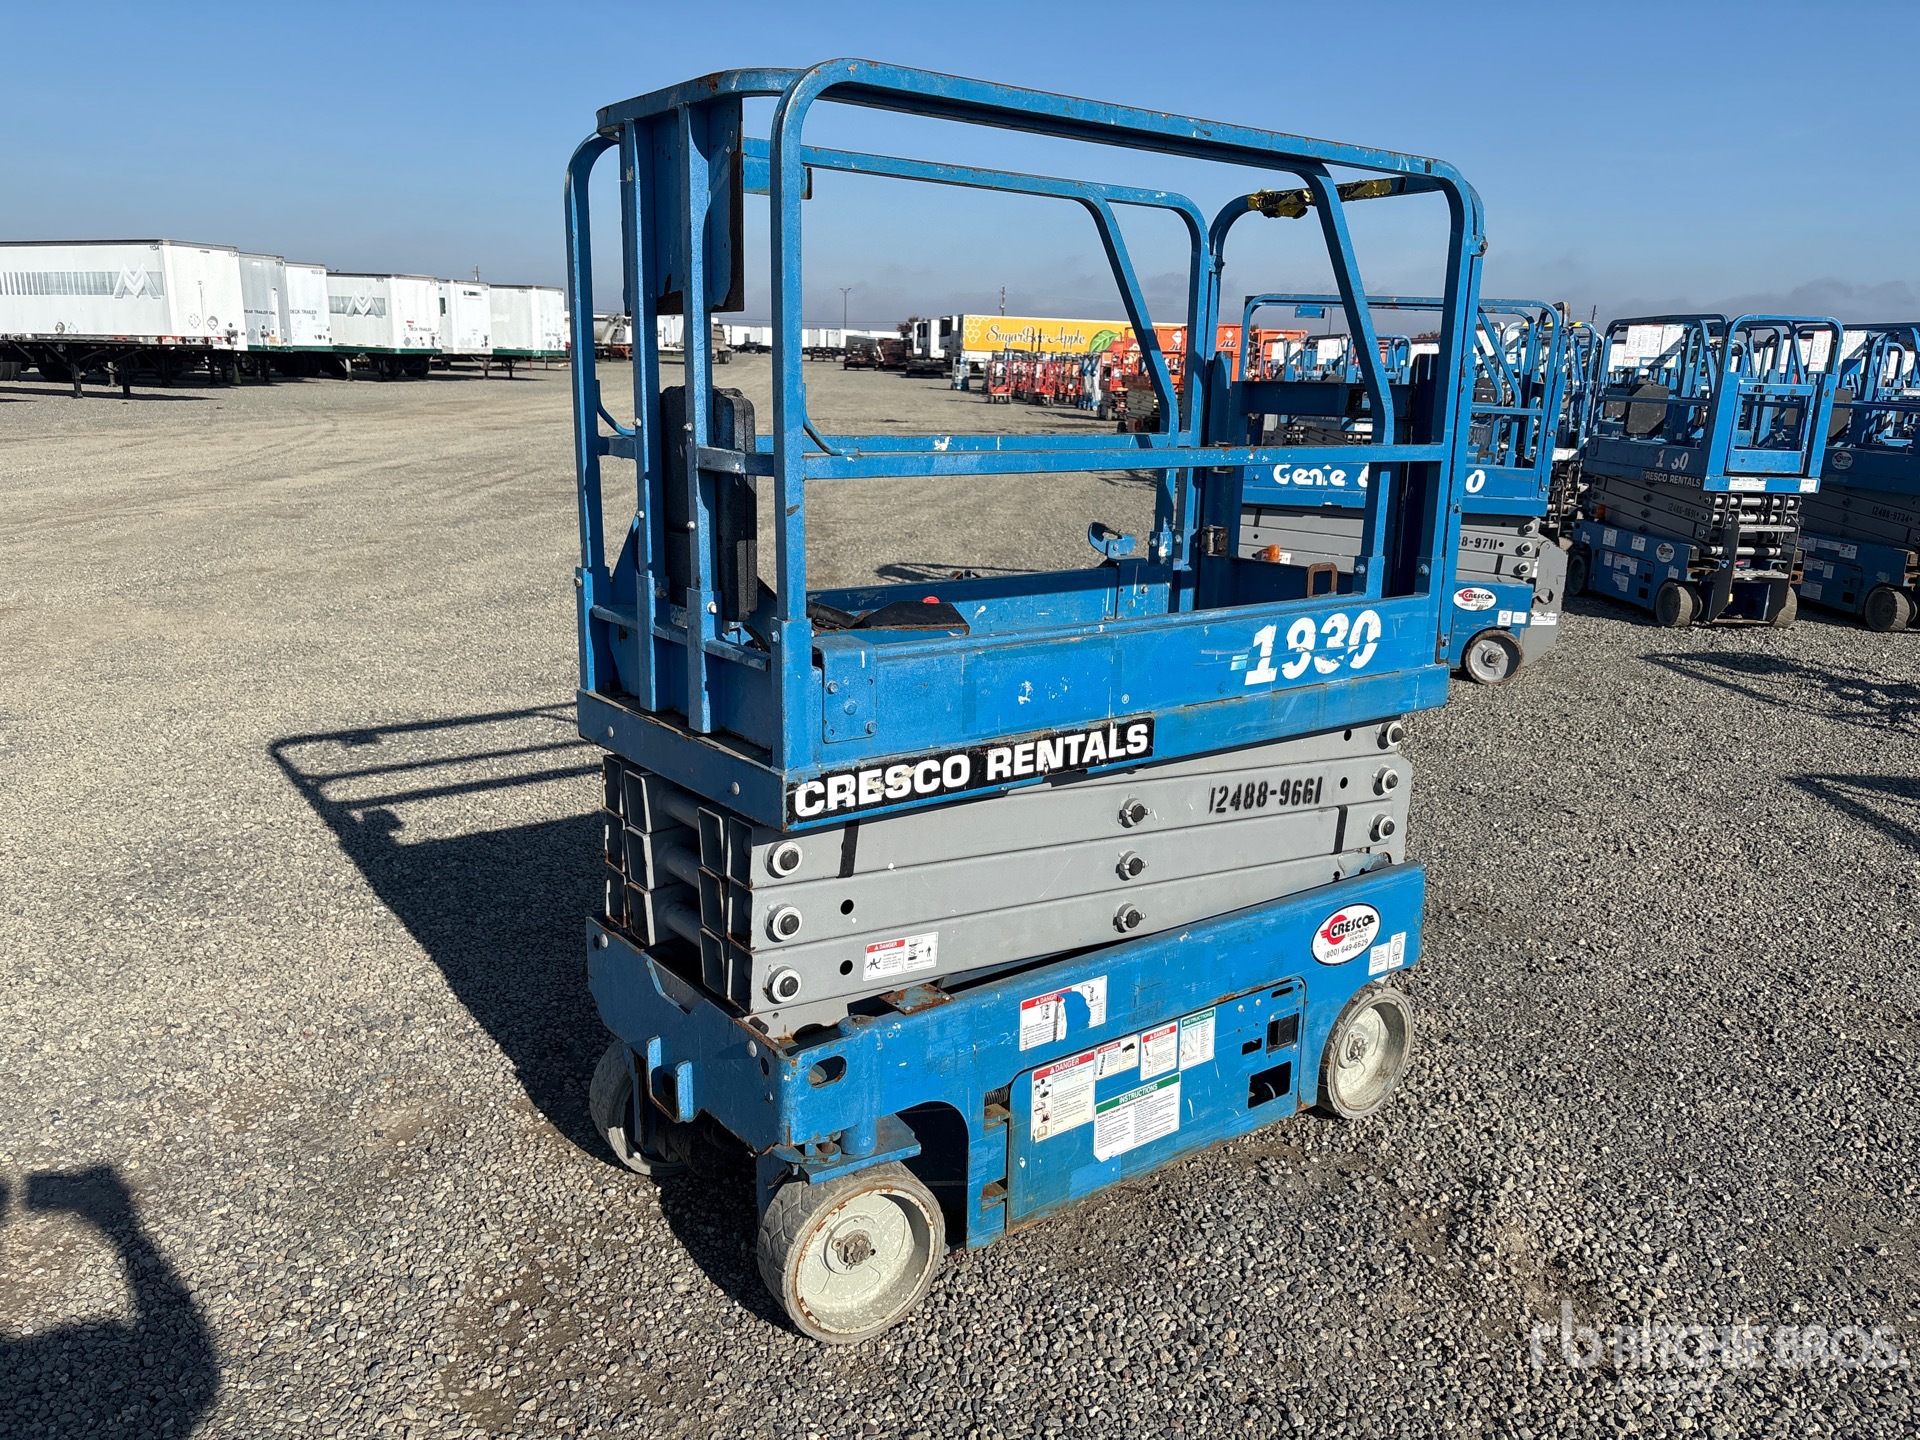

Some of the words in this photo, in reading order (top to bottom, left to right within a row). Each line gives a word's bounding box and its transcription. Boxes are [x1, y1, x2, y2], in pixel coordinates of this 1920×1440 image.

[1048, 326, 1086, 350] Apple
[1220, 340, 1237, 348] JLG
[1273, 464, 1346, 487] Genie
[1669, 474, 1701, 488] RENTALS
[1460, 536, 1498, 550] 8-9711
[1244, 609, 1382, 686] 1930
[795, 753, 971, 817] CRESCO
[986, 723, 1148, 781] RENTALS
[1209, 776, 1323, 814] 12488-9661
[1331, 914, 1375, 937] CRESCO
[879, 941, 898, 950] DANGER
[1324, 947, 1340, 960] (800)
[1040, 993, 1058, 1004] DANGE
[1154, 1027, 1171, 1039] DANGER
[1055, 1057, 1080, 1073] DANGER
[1118, 1083, 1158, 1104] INSTRUCTIONS
